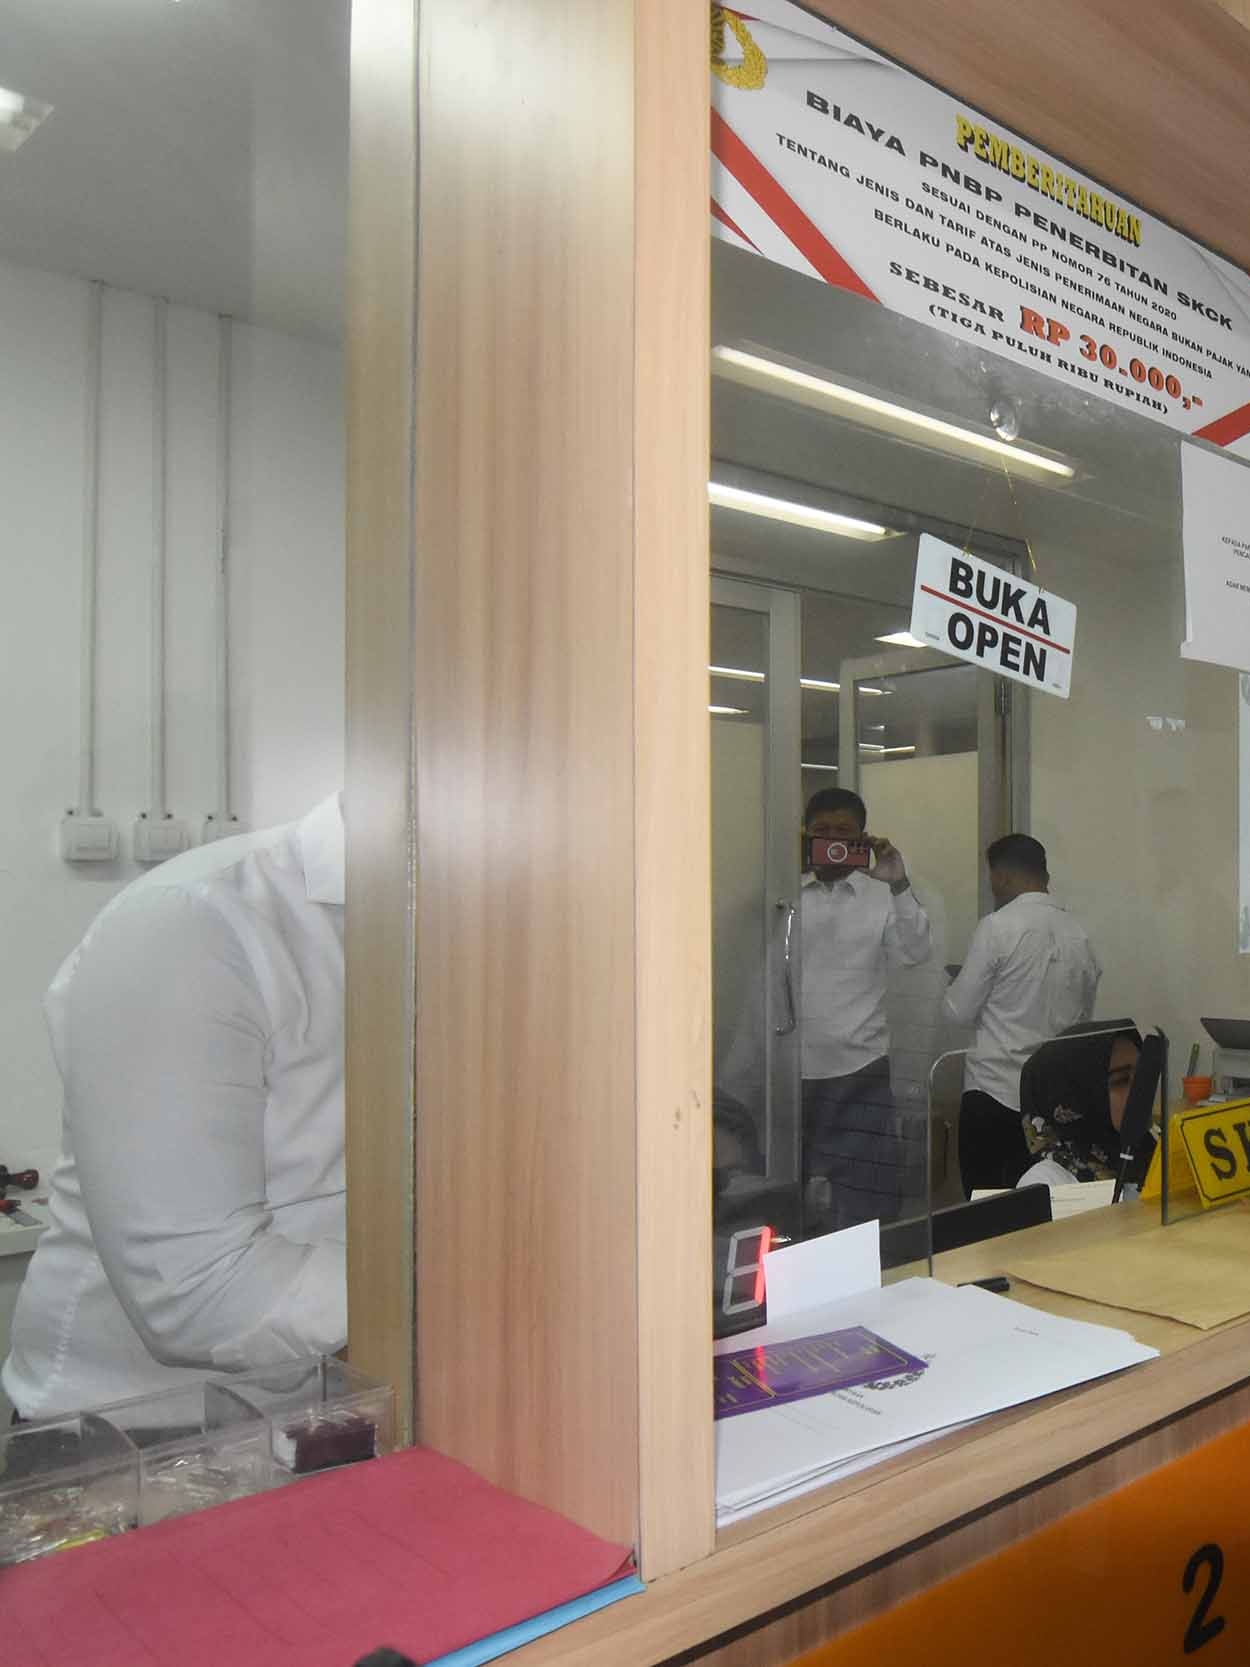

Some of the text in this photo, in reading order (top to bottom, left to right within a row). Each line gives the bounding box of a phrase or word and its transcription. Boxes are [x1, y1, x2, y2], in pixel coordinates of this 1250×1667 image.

[806, 90, 1233, 332] BIAYA PNBP PENERBITAN SKCK
[955, 112, 1143, 248] PEMBERITAHUAN
[776, 132, 851, 179] TENTANG
[856, 175, 900, 202] JENIS
[905, 197, 934, 219] DAN
[939, 213, 977, 239] TARIF
[980, 236, 1012, 258] ATAS
[1015, 254, 1050, 277] JENIS
[1055, 273, 1125, 315] PENERIMAAN
[1129, 308, 1168, 337] NEGARA
[1172, 331, 1203, 353] BUKAN
[1206, 349, 1234, 369] PAJAK
[874, 208, 1213, 379] BERLAKU PADA KEPOLISIAN NEGARA REPUBLIK INDONESIA
[889, 261, 1005, 322] SEBESAR
[1019, 304, 1071, 348] RP
[921, 182, 1177, 321] SESUAI DENGAN PP NOMOR 76 TAHUN 2020
[928, 304, 1168, 415] (TIGA PULUH RIBU RUPIAH)
[947, 612, 1047, 682] OPEN
[949, 557, 1050, 636] BUKA
[1182, 1543, 1225, 1654] 2
